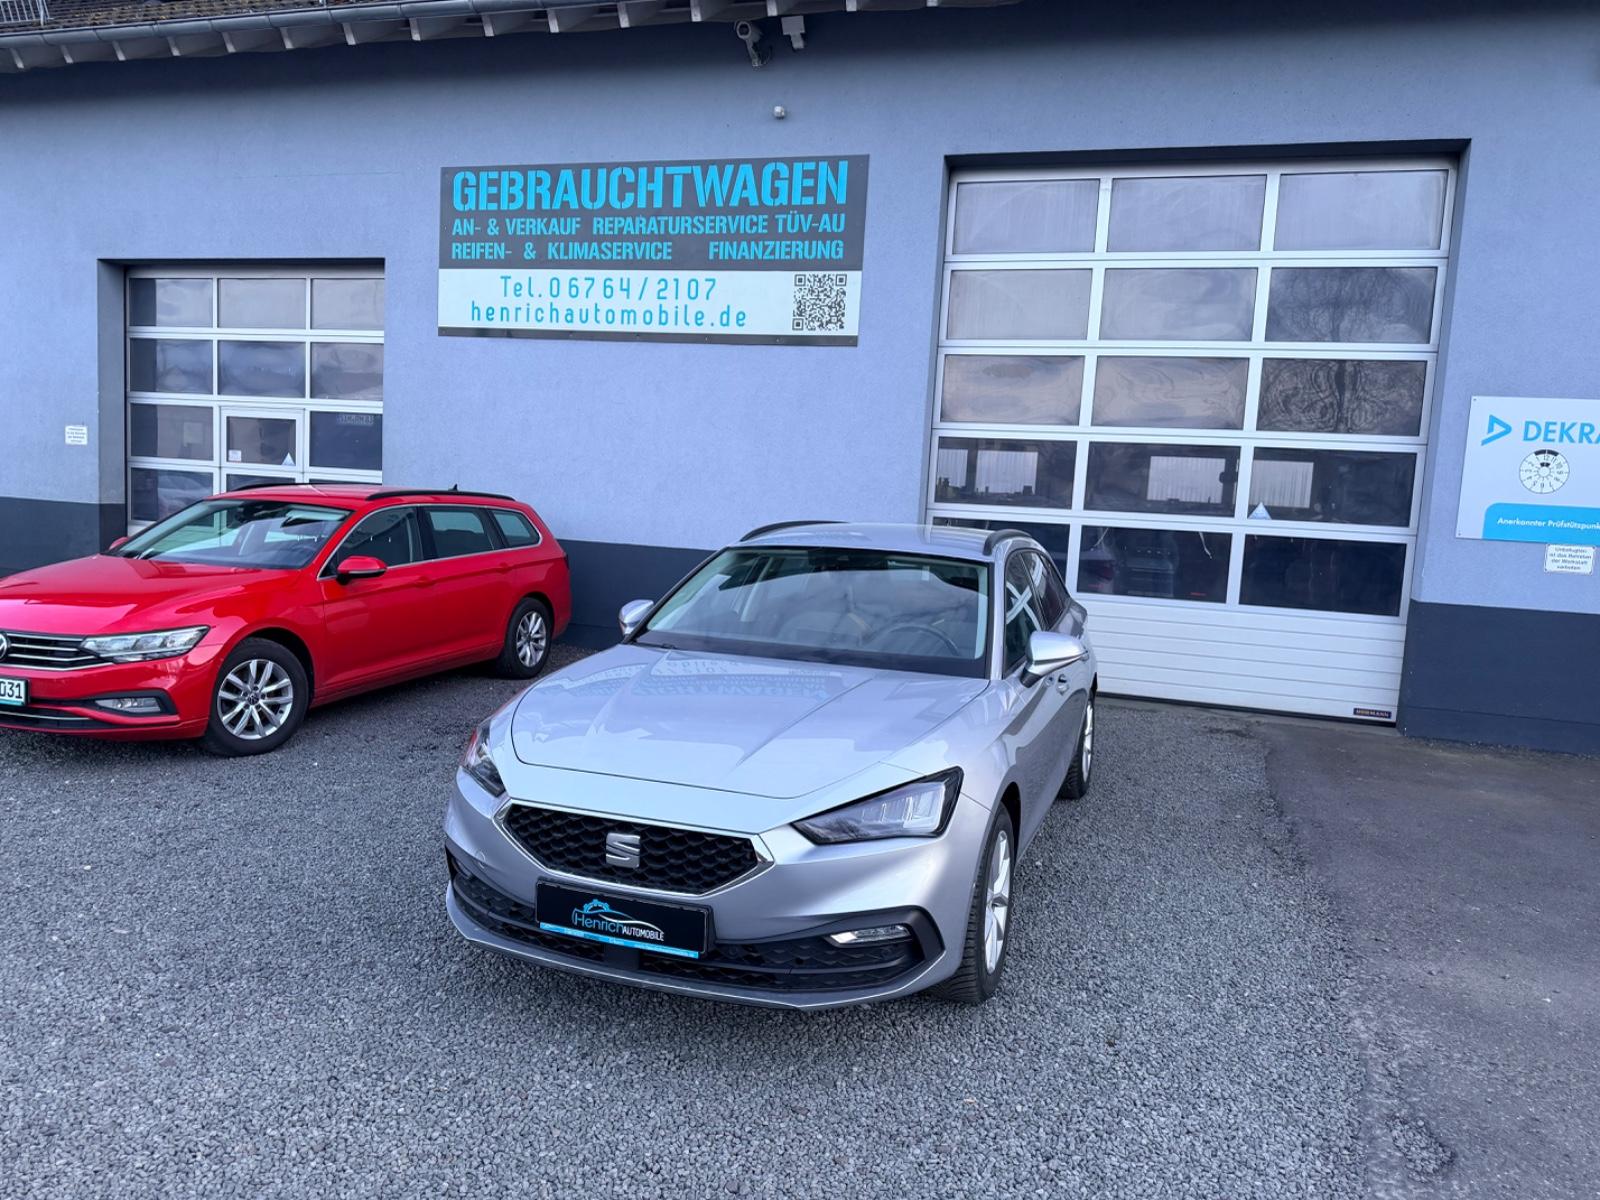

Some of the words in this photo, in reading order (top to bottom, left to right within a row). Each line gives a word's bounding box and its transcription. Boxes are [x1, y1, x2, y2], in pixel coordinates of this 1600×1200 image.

[452, 160, 849, 212] GEBRAUCHTWAGEN
[452, 217, 482, 236] AN-
[487, 217, 499, 236] &
[505, 216, 582, 236] VERKAUF
[592, 213, 769, 236] REPARATURSERVICE
[775, 210, 846, 234] TÜV-AU
[451, 241, 512, 260] REIFEN-
[523, 241, 537, 260] &
[547, 241, 673, 261] KLIMASERVICE
[708, 239, 844, 261] FINANZIERUNG
[471, 300, 747, 328] henrichautomobile.de
[1497, 516, 1546, 528] Anerkannter
[575, 912, 624, 933] Henrich
[622, 925, 665, 942] AUTOMOBILE
